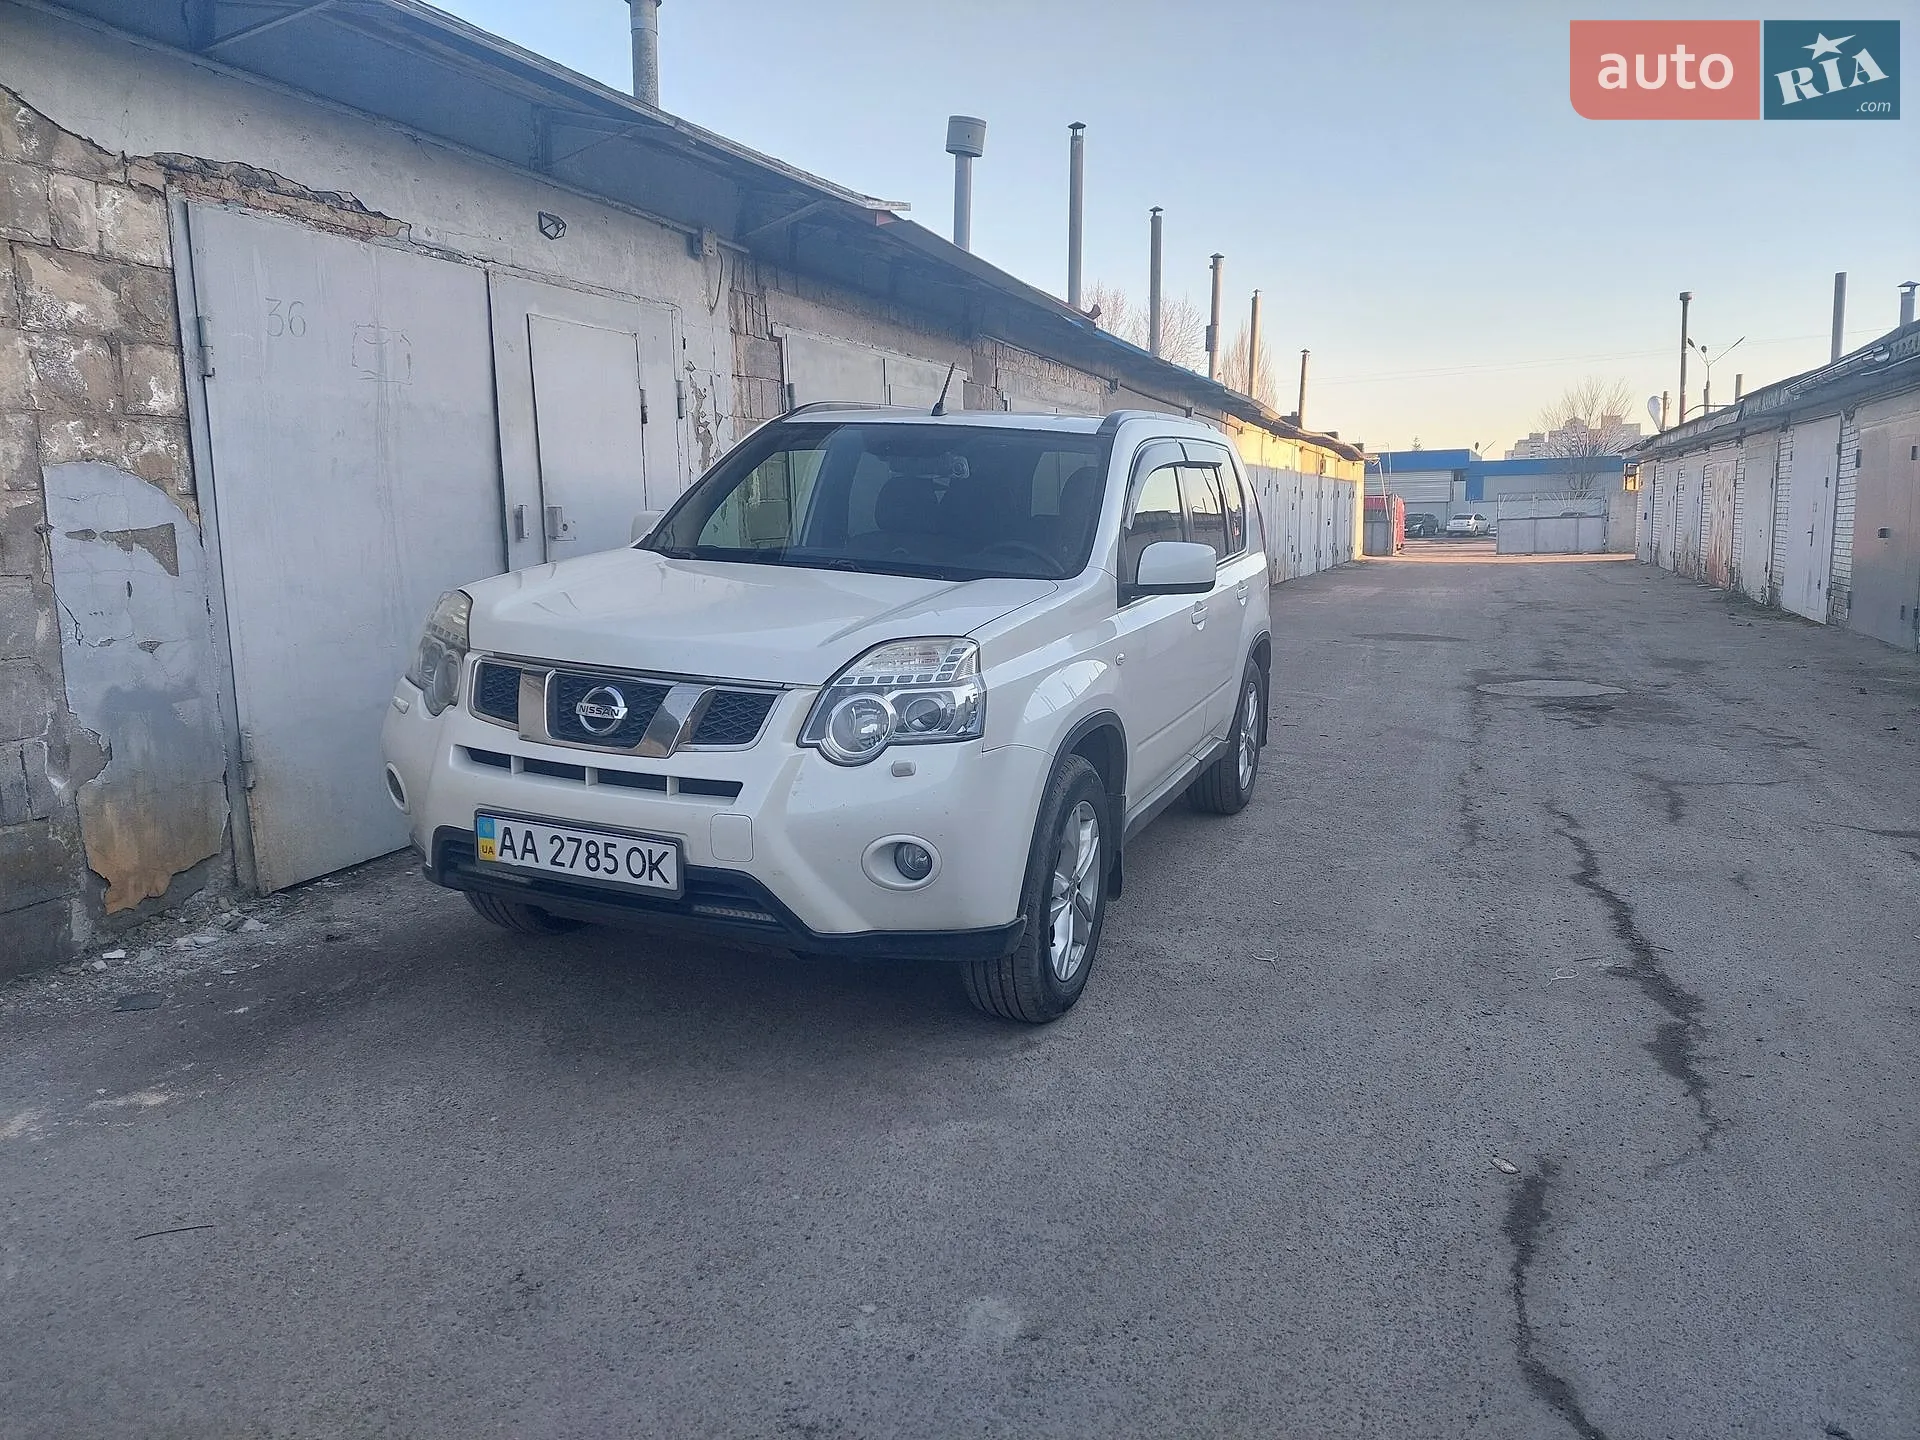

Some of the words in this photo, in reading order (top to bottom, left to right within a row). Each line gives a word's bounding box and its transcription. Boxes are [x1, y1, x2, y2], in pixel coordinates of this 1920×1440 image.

[265, 297, 306, 337] 36
[580, 705, 620, 718] NISSAN
[481, 845, 494, 855] UA
[499, 827, 539, 863] AA
[549, 835, 618, 875] 2785
[626, 847, 669, 884] OK
